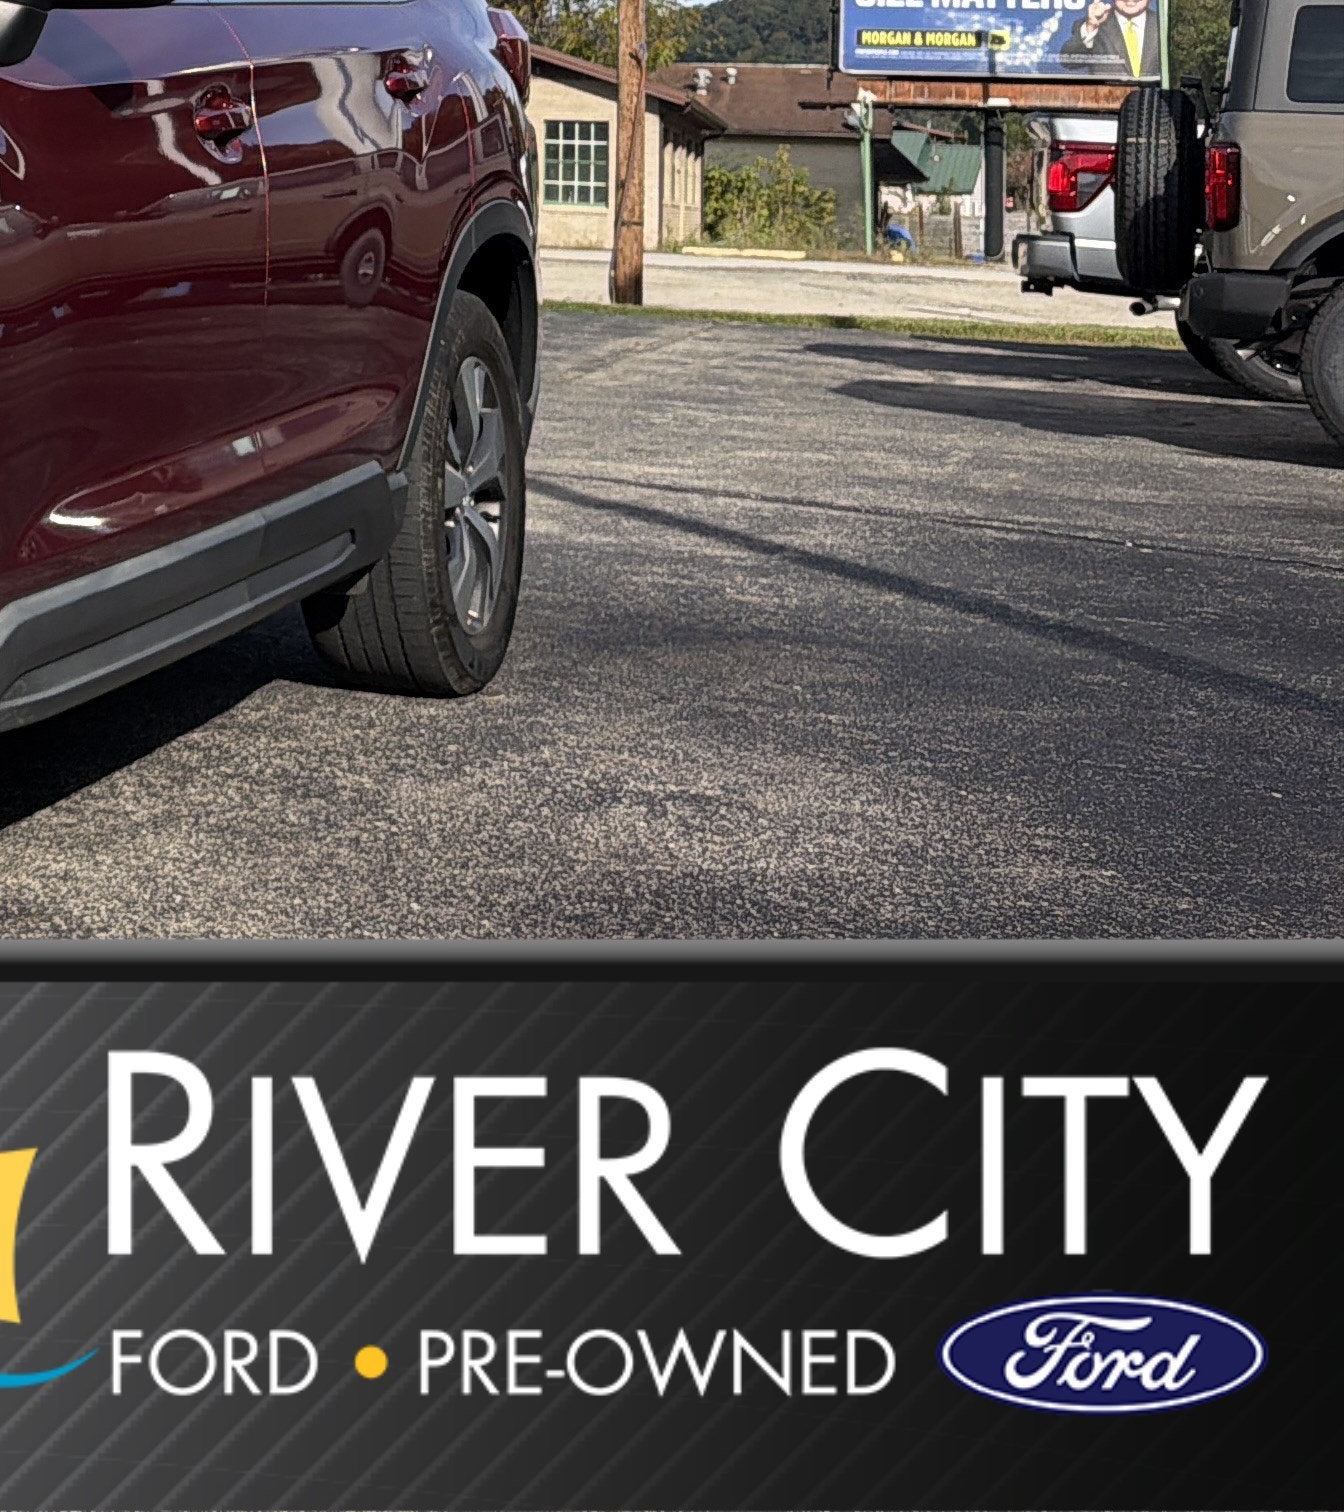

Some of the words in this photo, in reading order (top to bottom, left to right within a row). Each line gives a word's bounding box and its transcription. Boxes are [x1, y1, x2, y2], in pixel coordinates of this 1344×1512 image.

[862, 30, 912, 46] MORGAN
[913, 31, 924, 46] &
[925, 31, 977, 47] MORGAN
